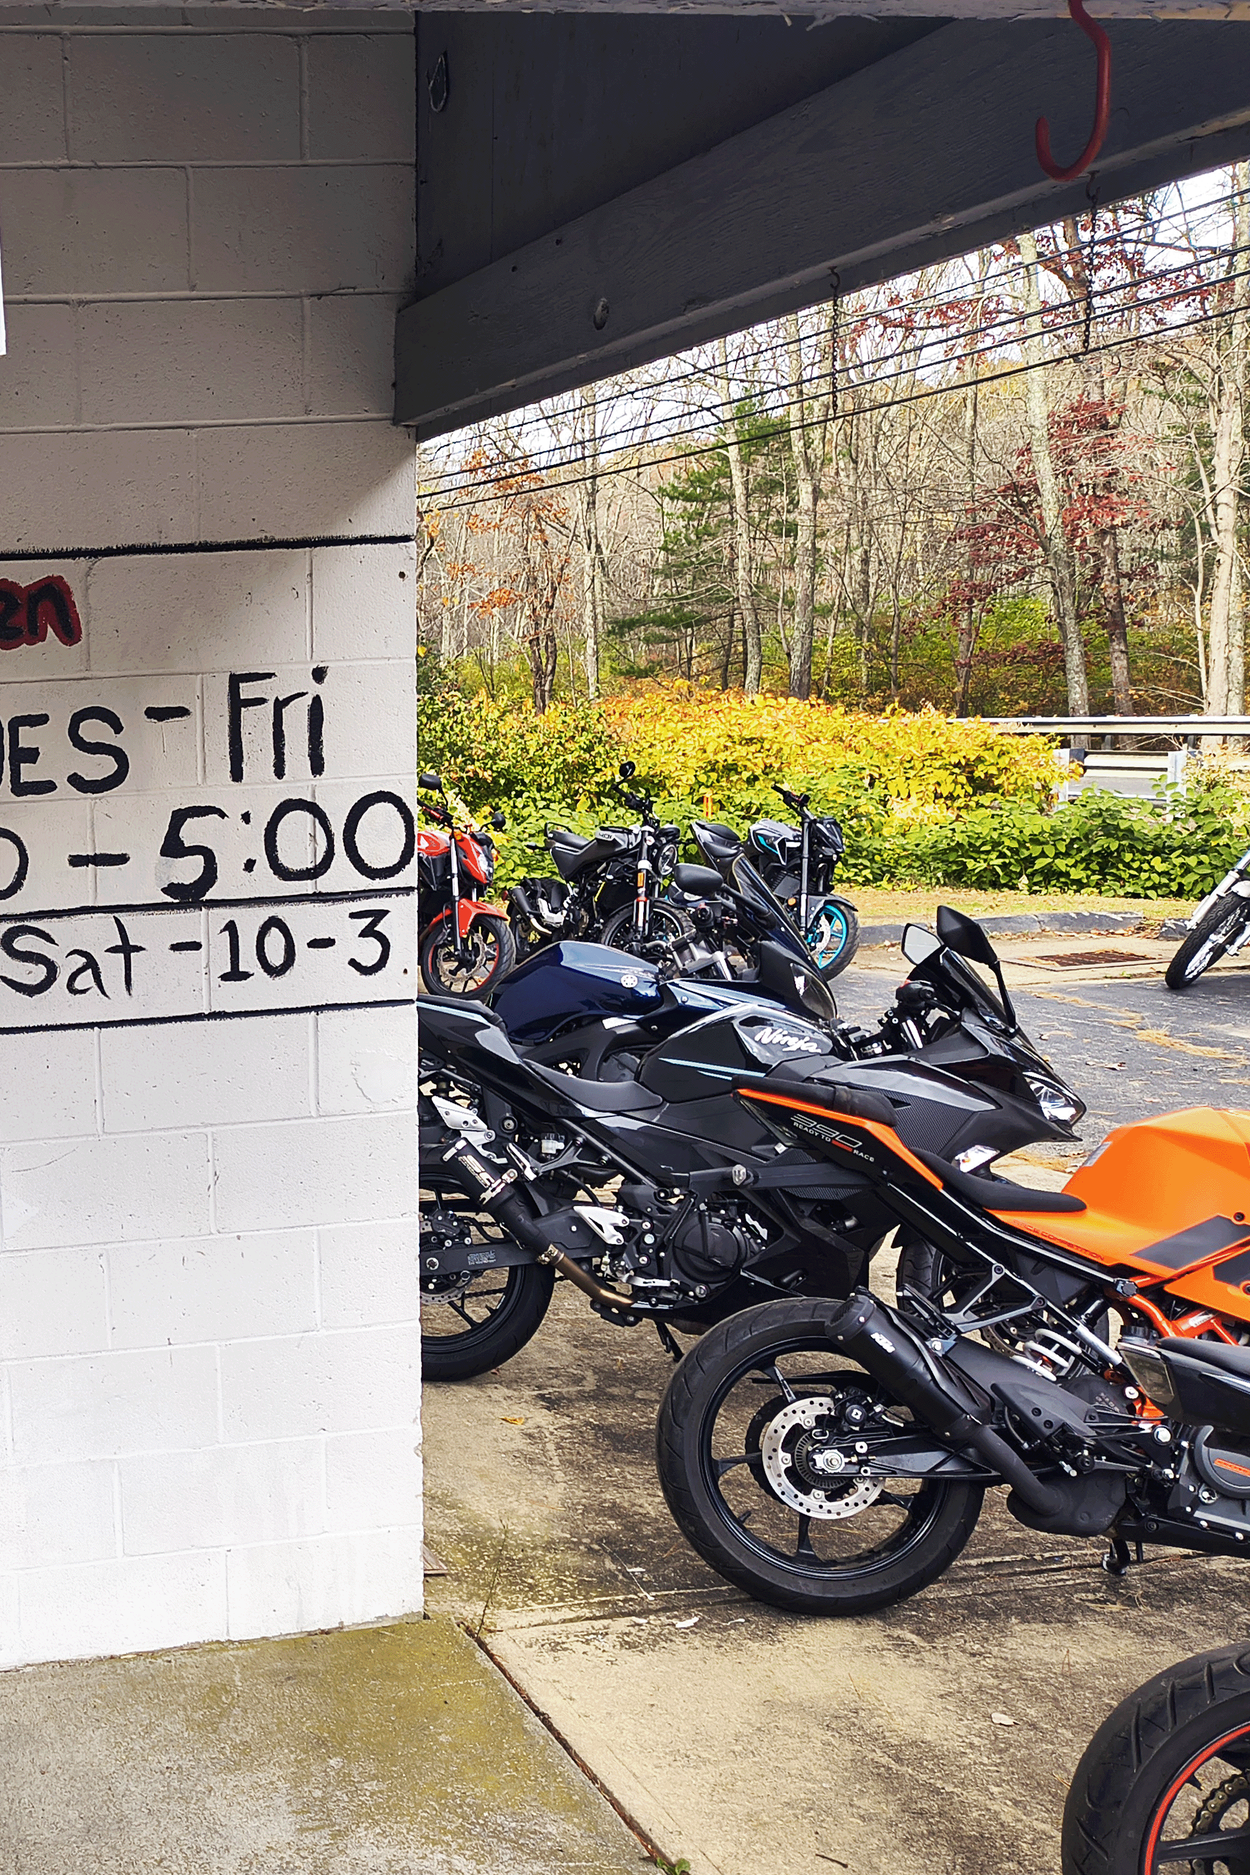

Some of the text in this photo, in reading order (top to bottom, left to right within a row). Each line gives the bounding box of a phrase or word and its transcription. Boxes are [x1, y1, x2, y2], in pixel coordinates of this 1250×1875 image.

[227, 665, 329, 783] Fri
[159, 790, 416, 902] 5:00
[0, 915, 147, 999] Sat
[754, 1027, 822, 1054] Ninja
[793, 1121, 875, 1163] READY TO RACE
[870, 1332, 896, 1353] KTM
